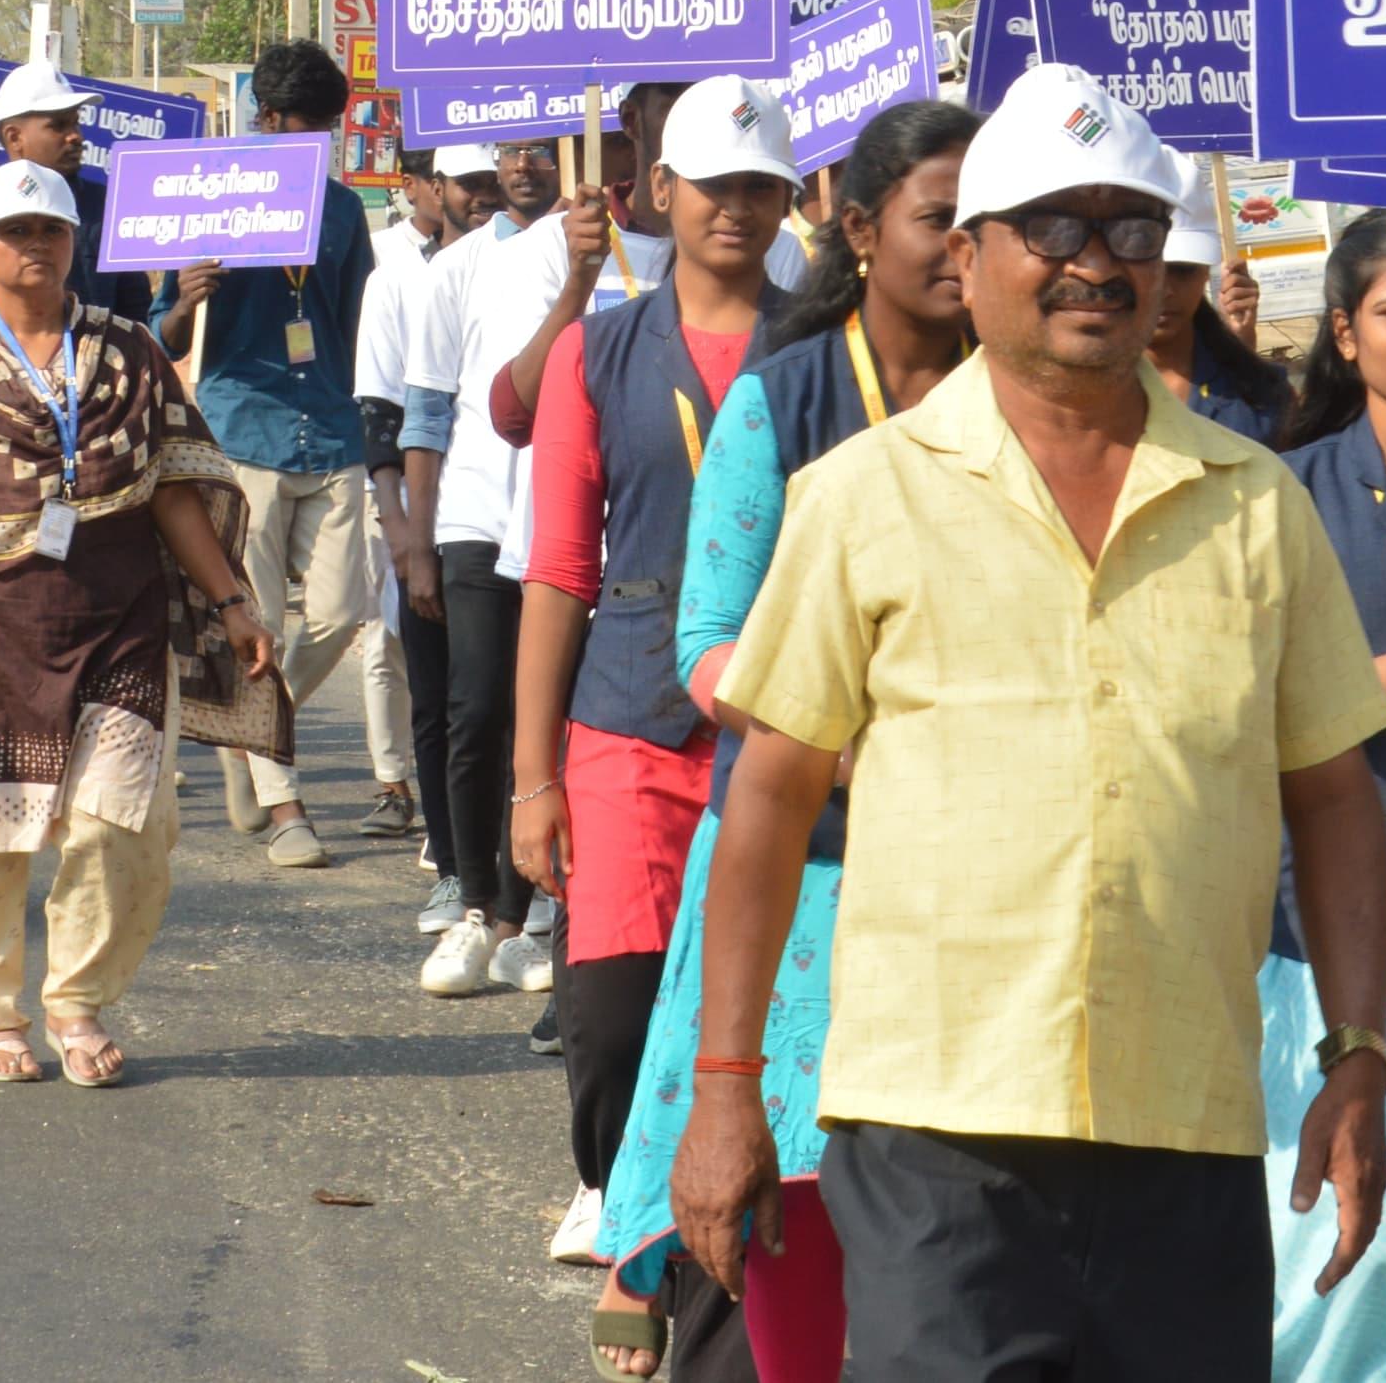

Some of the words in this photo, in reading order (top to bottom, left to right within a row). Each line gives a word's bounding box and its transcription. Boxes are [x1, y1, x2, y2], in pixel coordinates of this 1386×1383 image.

[825, 6, 894, 72] பருவம்
[152, 162, 280, 200] வாக்குரிமை
[117, 214, 182, 246] எனது
[180, 201, 306, 243] நாட்டுரிமை
